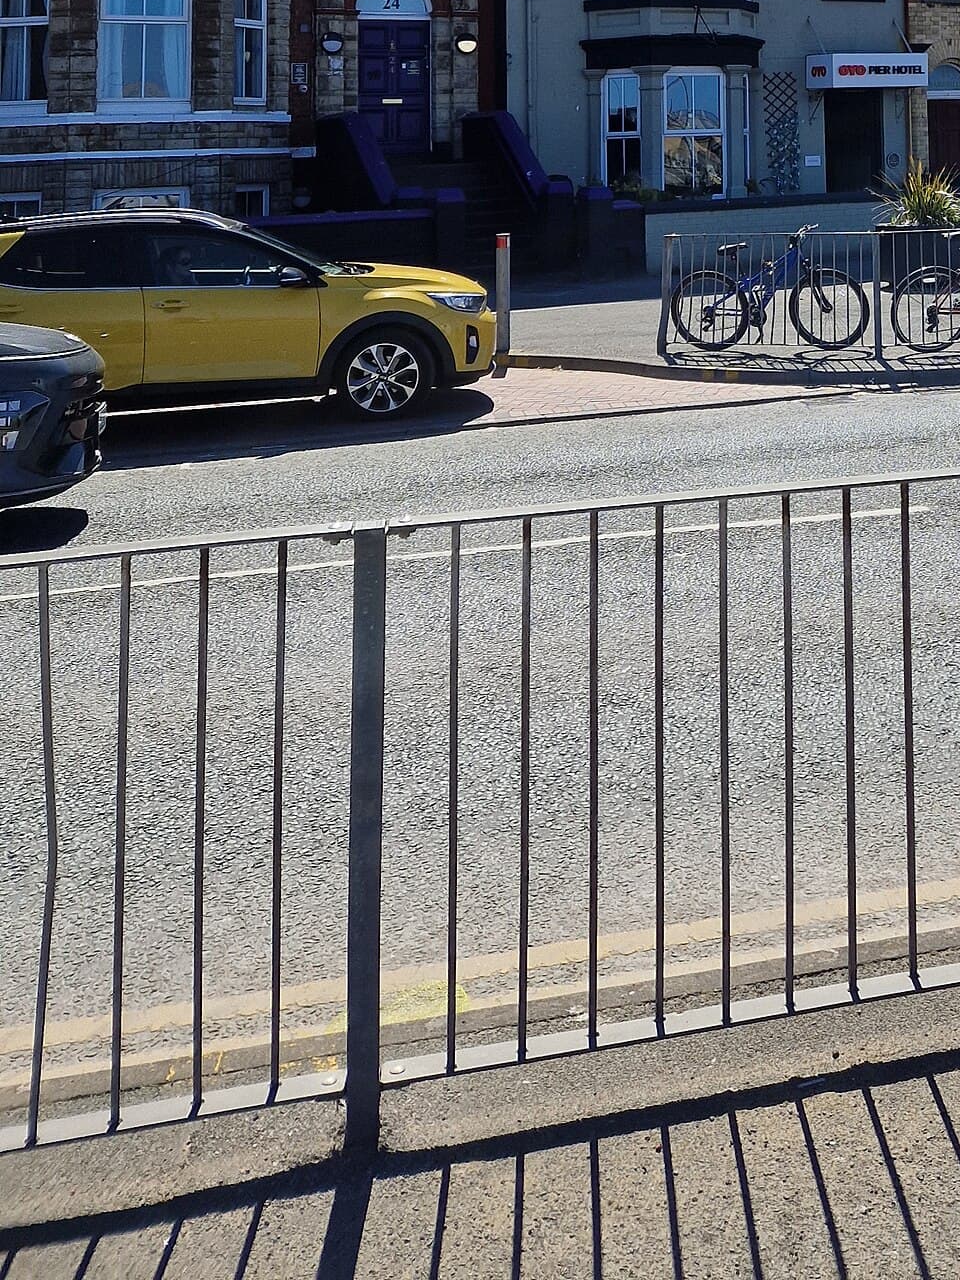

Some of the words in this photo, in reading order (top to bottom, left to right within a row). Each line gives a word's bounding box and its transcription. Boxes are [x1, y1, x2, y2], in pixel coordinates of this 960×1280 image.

[838, 64, 867, 76] OYO
[868, 65, 891, 75] PIER
[892, 65, 926, 75] HOTEL
